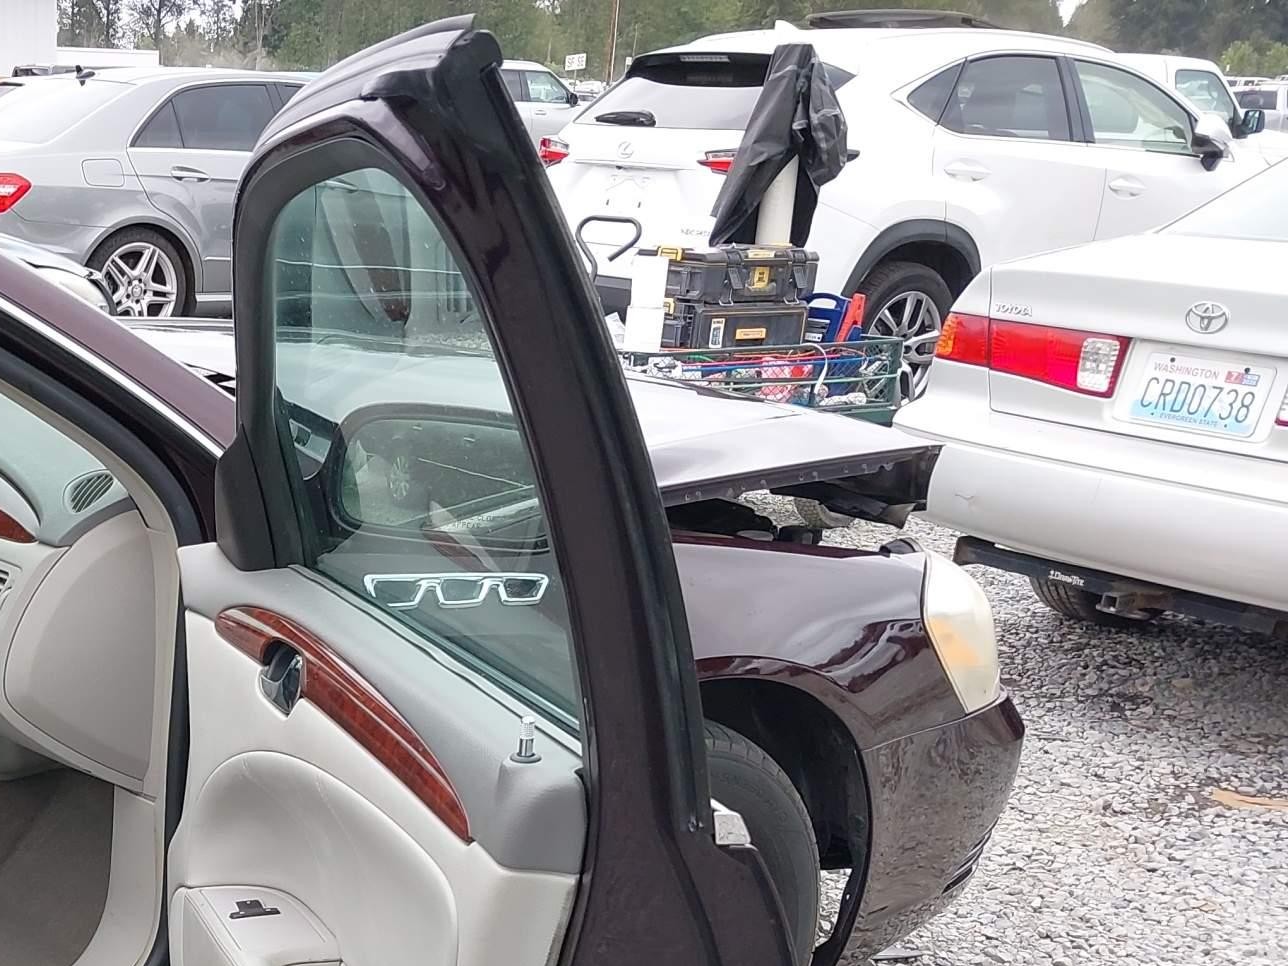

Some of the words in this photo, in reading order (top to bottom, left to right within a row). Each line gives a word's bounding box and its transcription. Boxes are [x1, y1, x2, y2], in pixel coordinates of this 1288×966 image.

[995, 303, 1032, 317] TOYOTA
[1153, 361, 1220, 381] WASHINGTON
[1140, 376, 1256, 424] CRD0738
[1159, 412, 1197, 424] EVERGREEN
